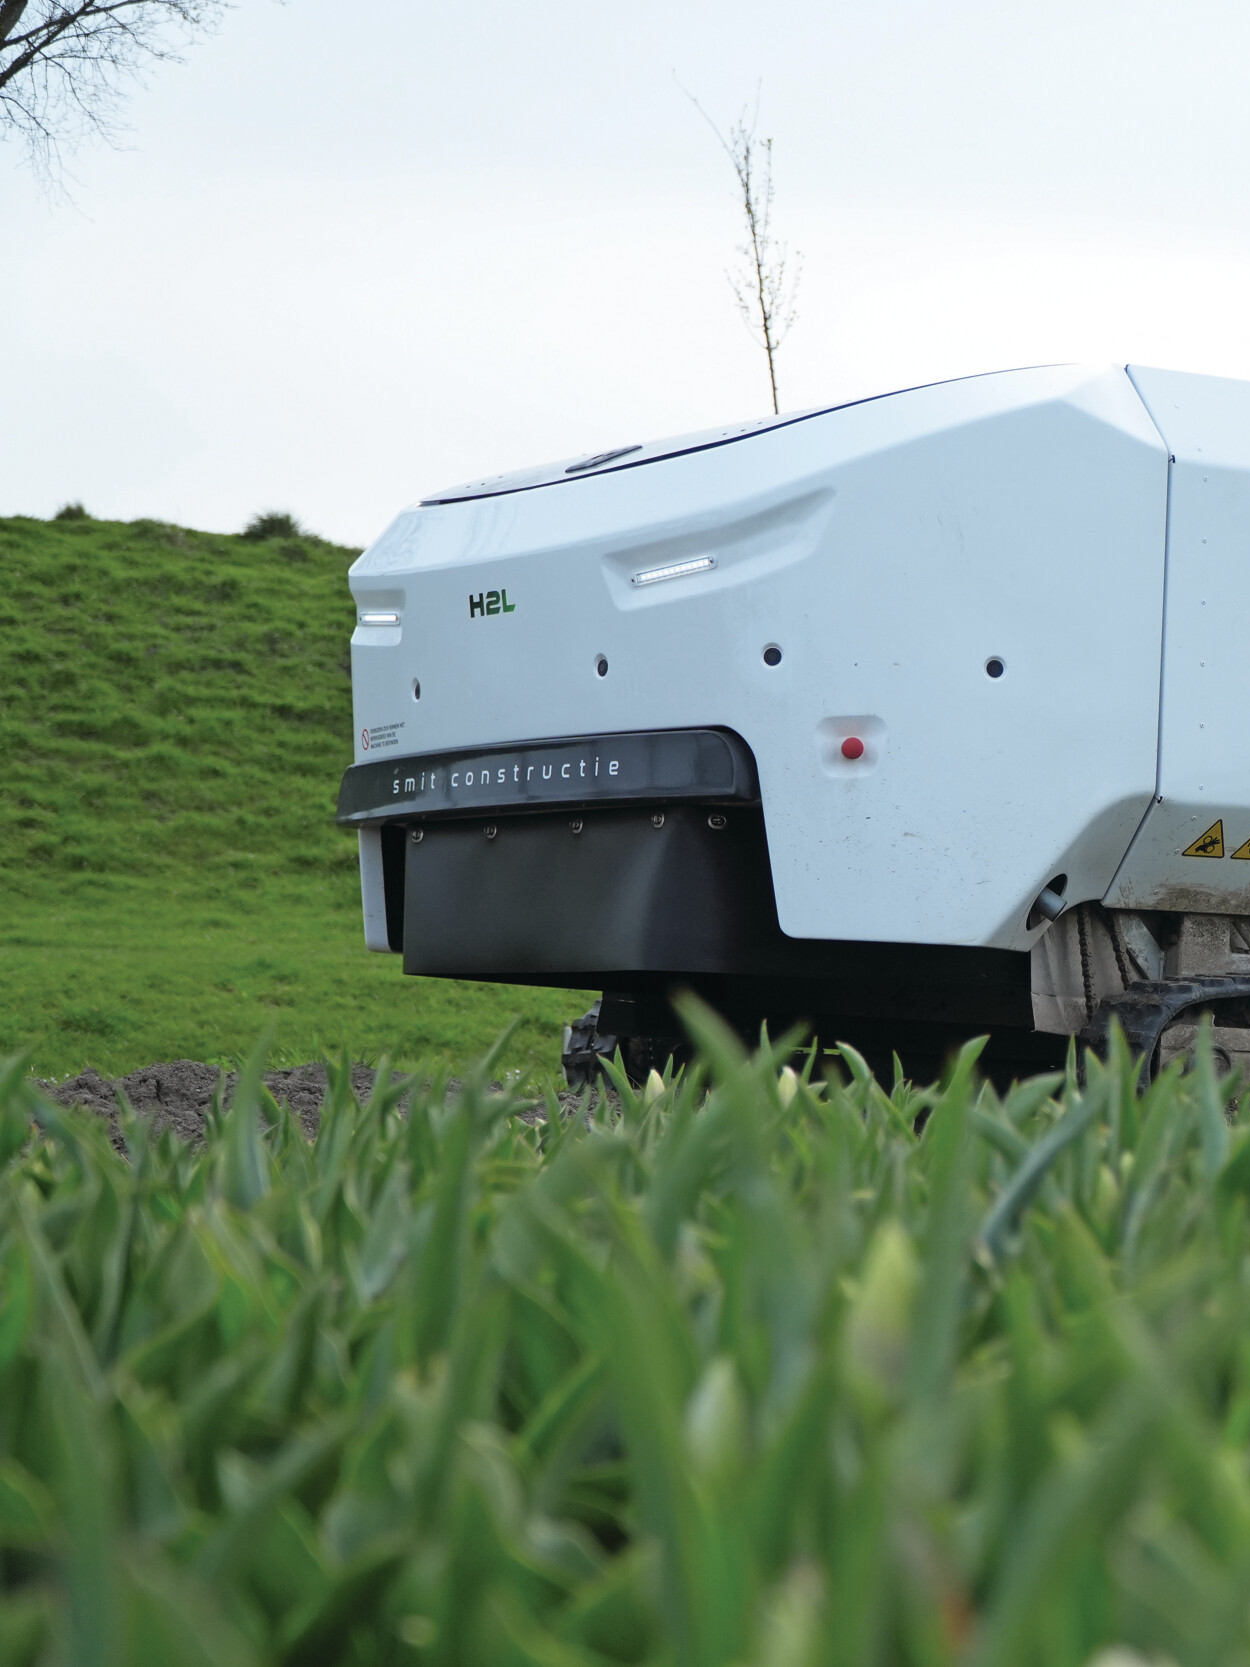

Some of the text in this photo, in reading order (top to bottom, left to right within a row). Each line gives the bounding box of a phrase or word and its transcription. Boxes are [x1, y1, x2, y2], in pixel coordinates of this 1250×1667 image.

[469, 589, 516, 618] H2L
[393, 757, 620, 794] smit constructie
